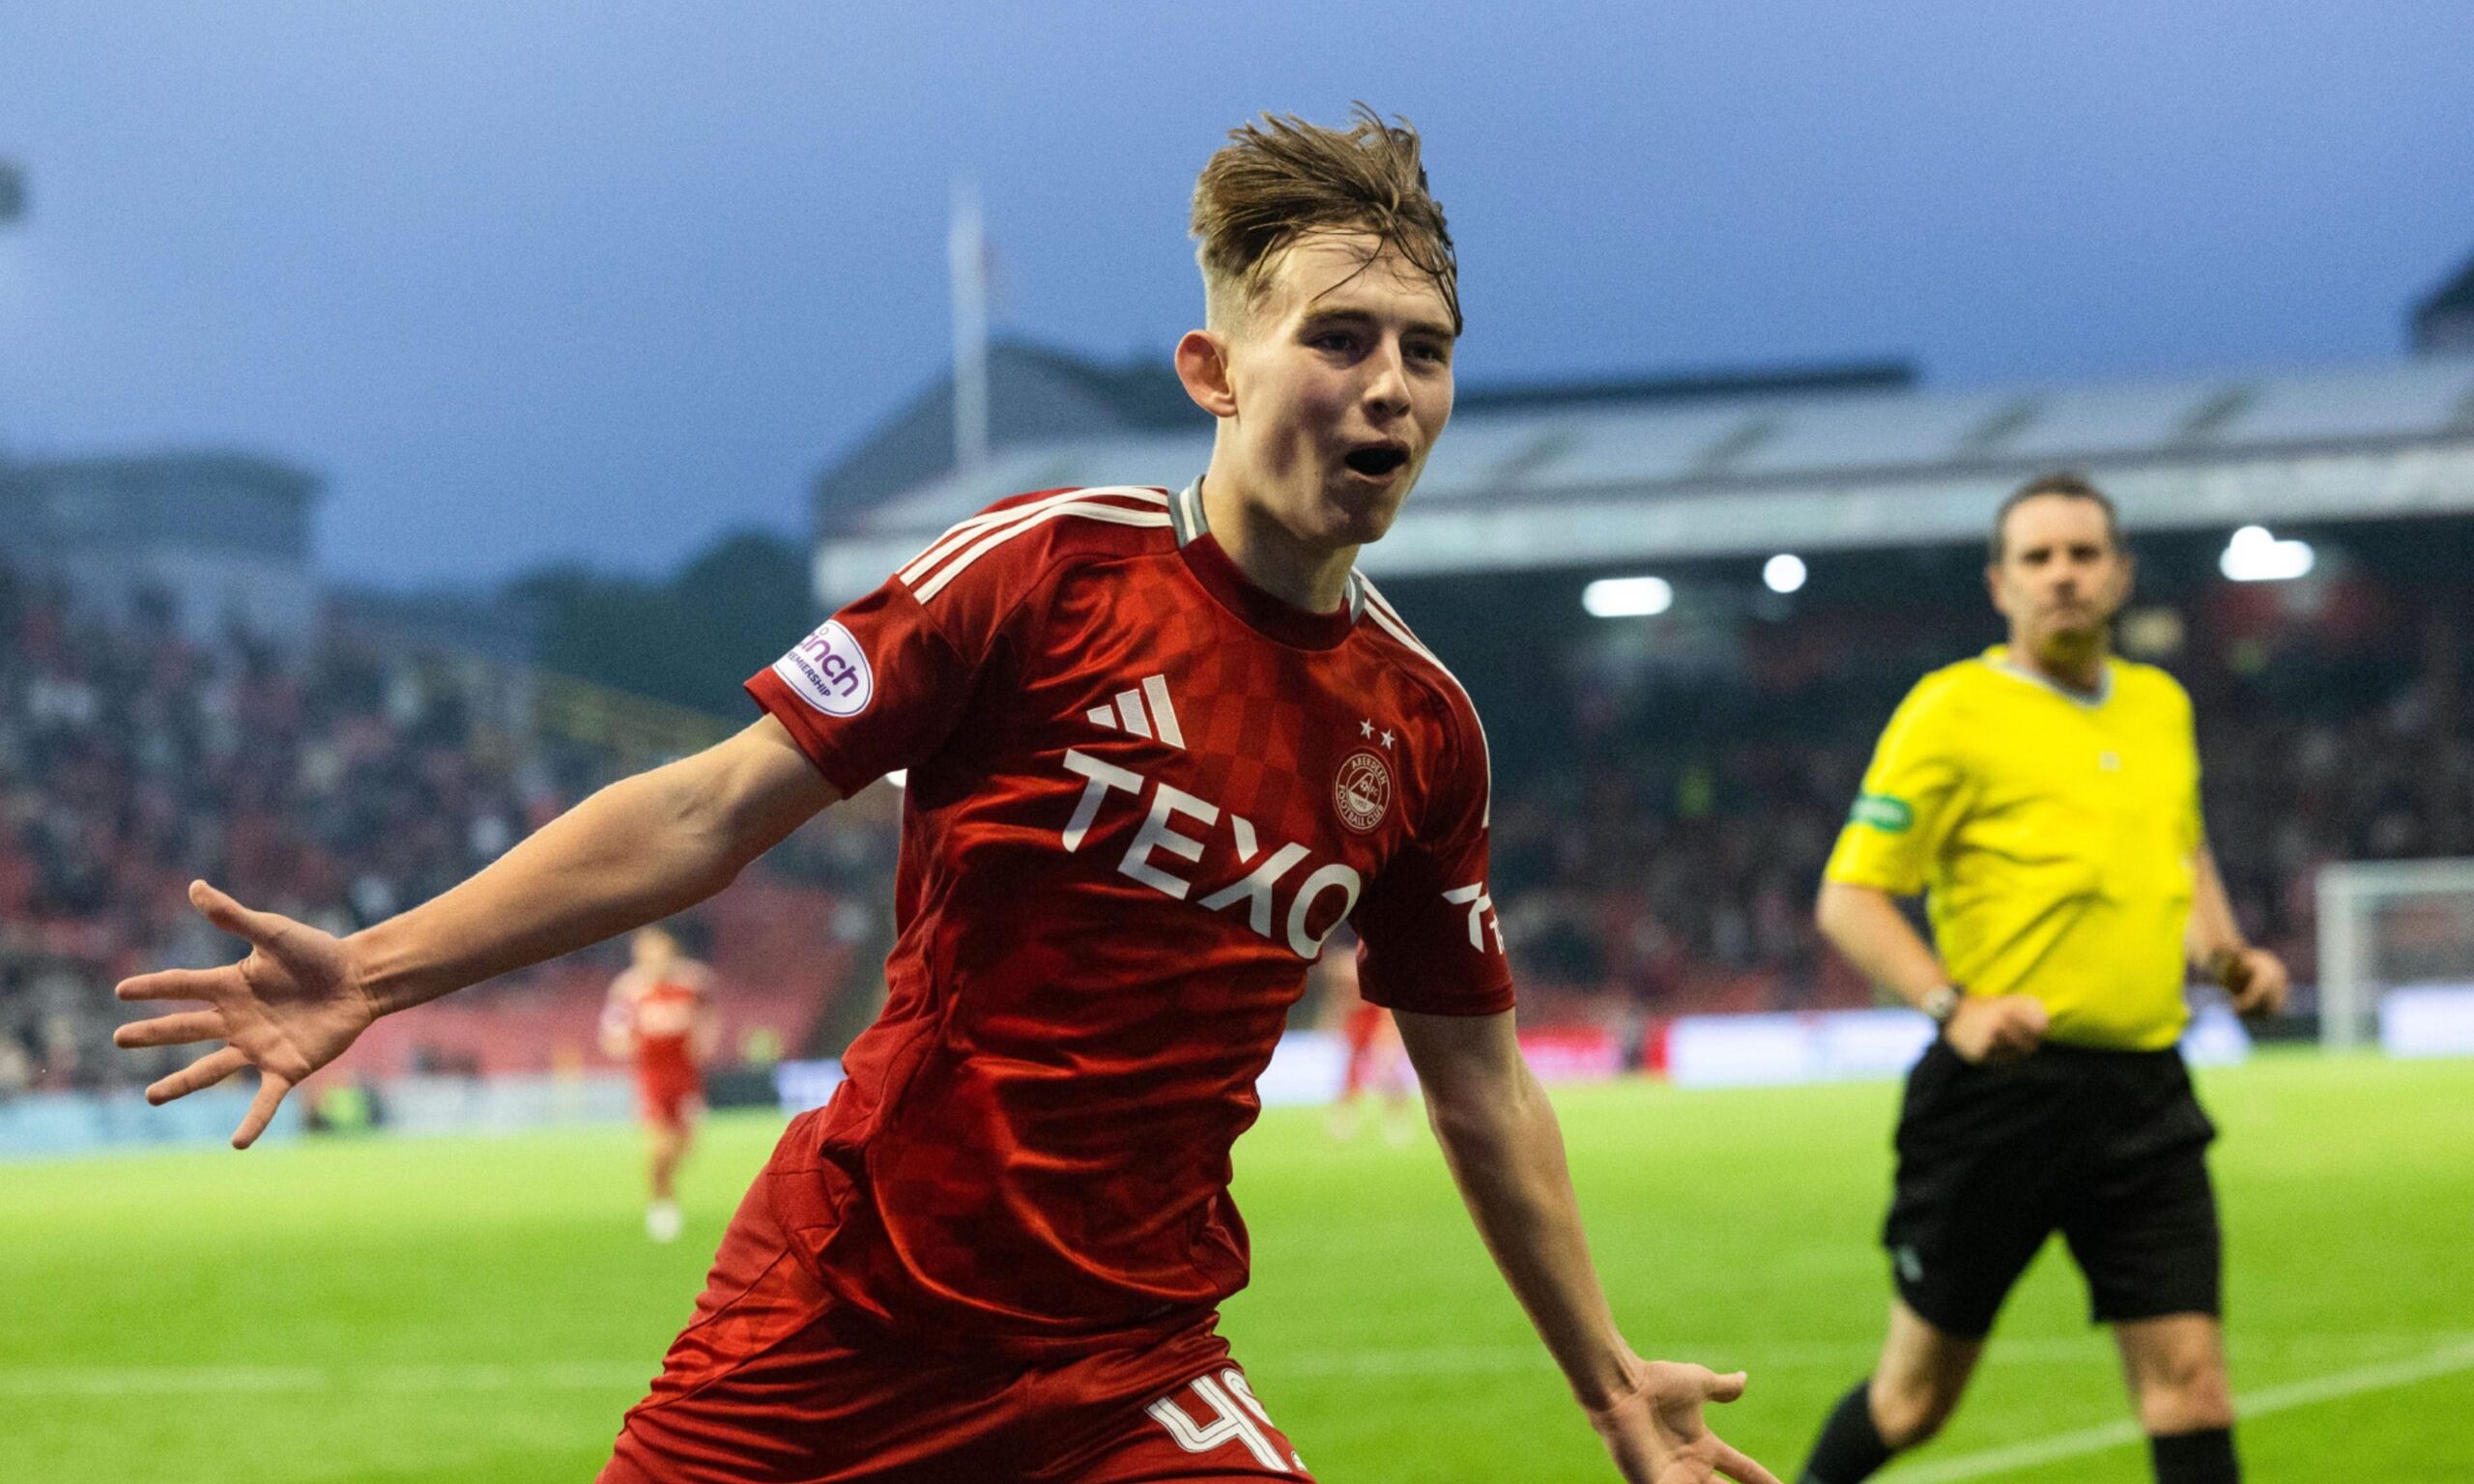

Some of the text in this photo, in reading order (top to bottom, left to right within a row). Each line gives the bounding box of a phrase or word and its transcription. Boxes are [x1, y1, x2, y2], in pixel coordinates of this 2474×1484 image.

[1351, 756, 1388, 785] ABERDEEN
[1338, 785, 1366, 826] FOOTBALL
[1366, 804, 1386, 825] CLUB
[1062, 748, 1362, 959] TEXO
